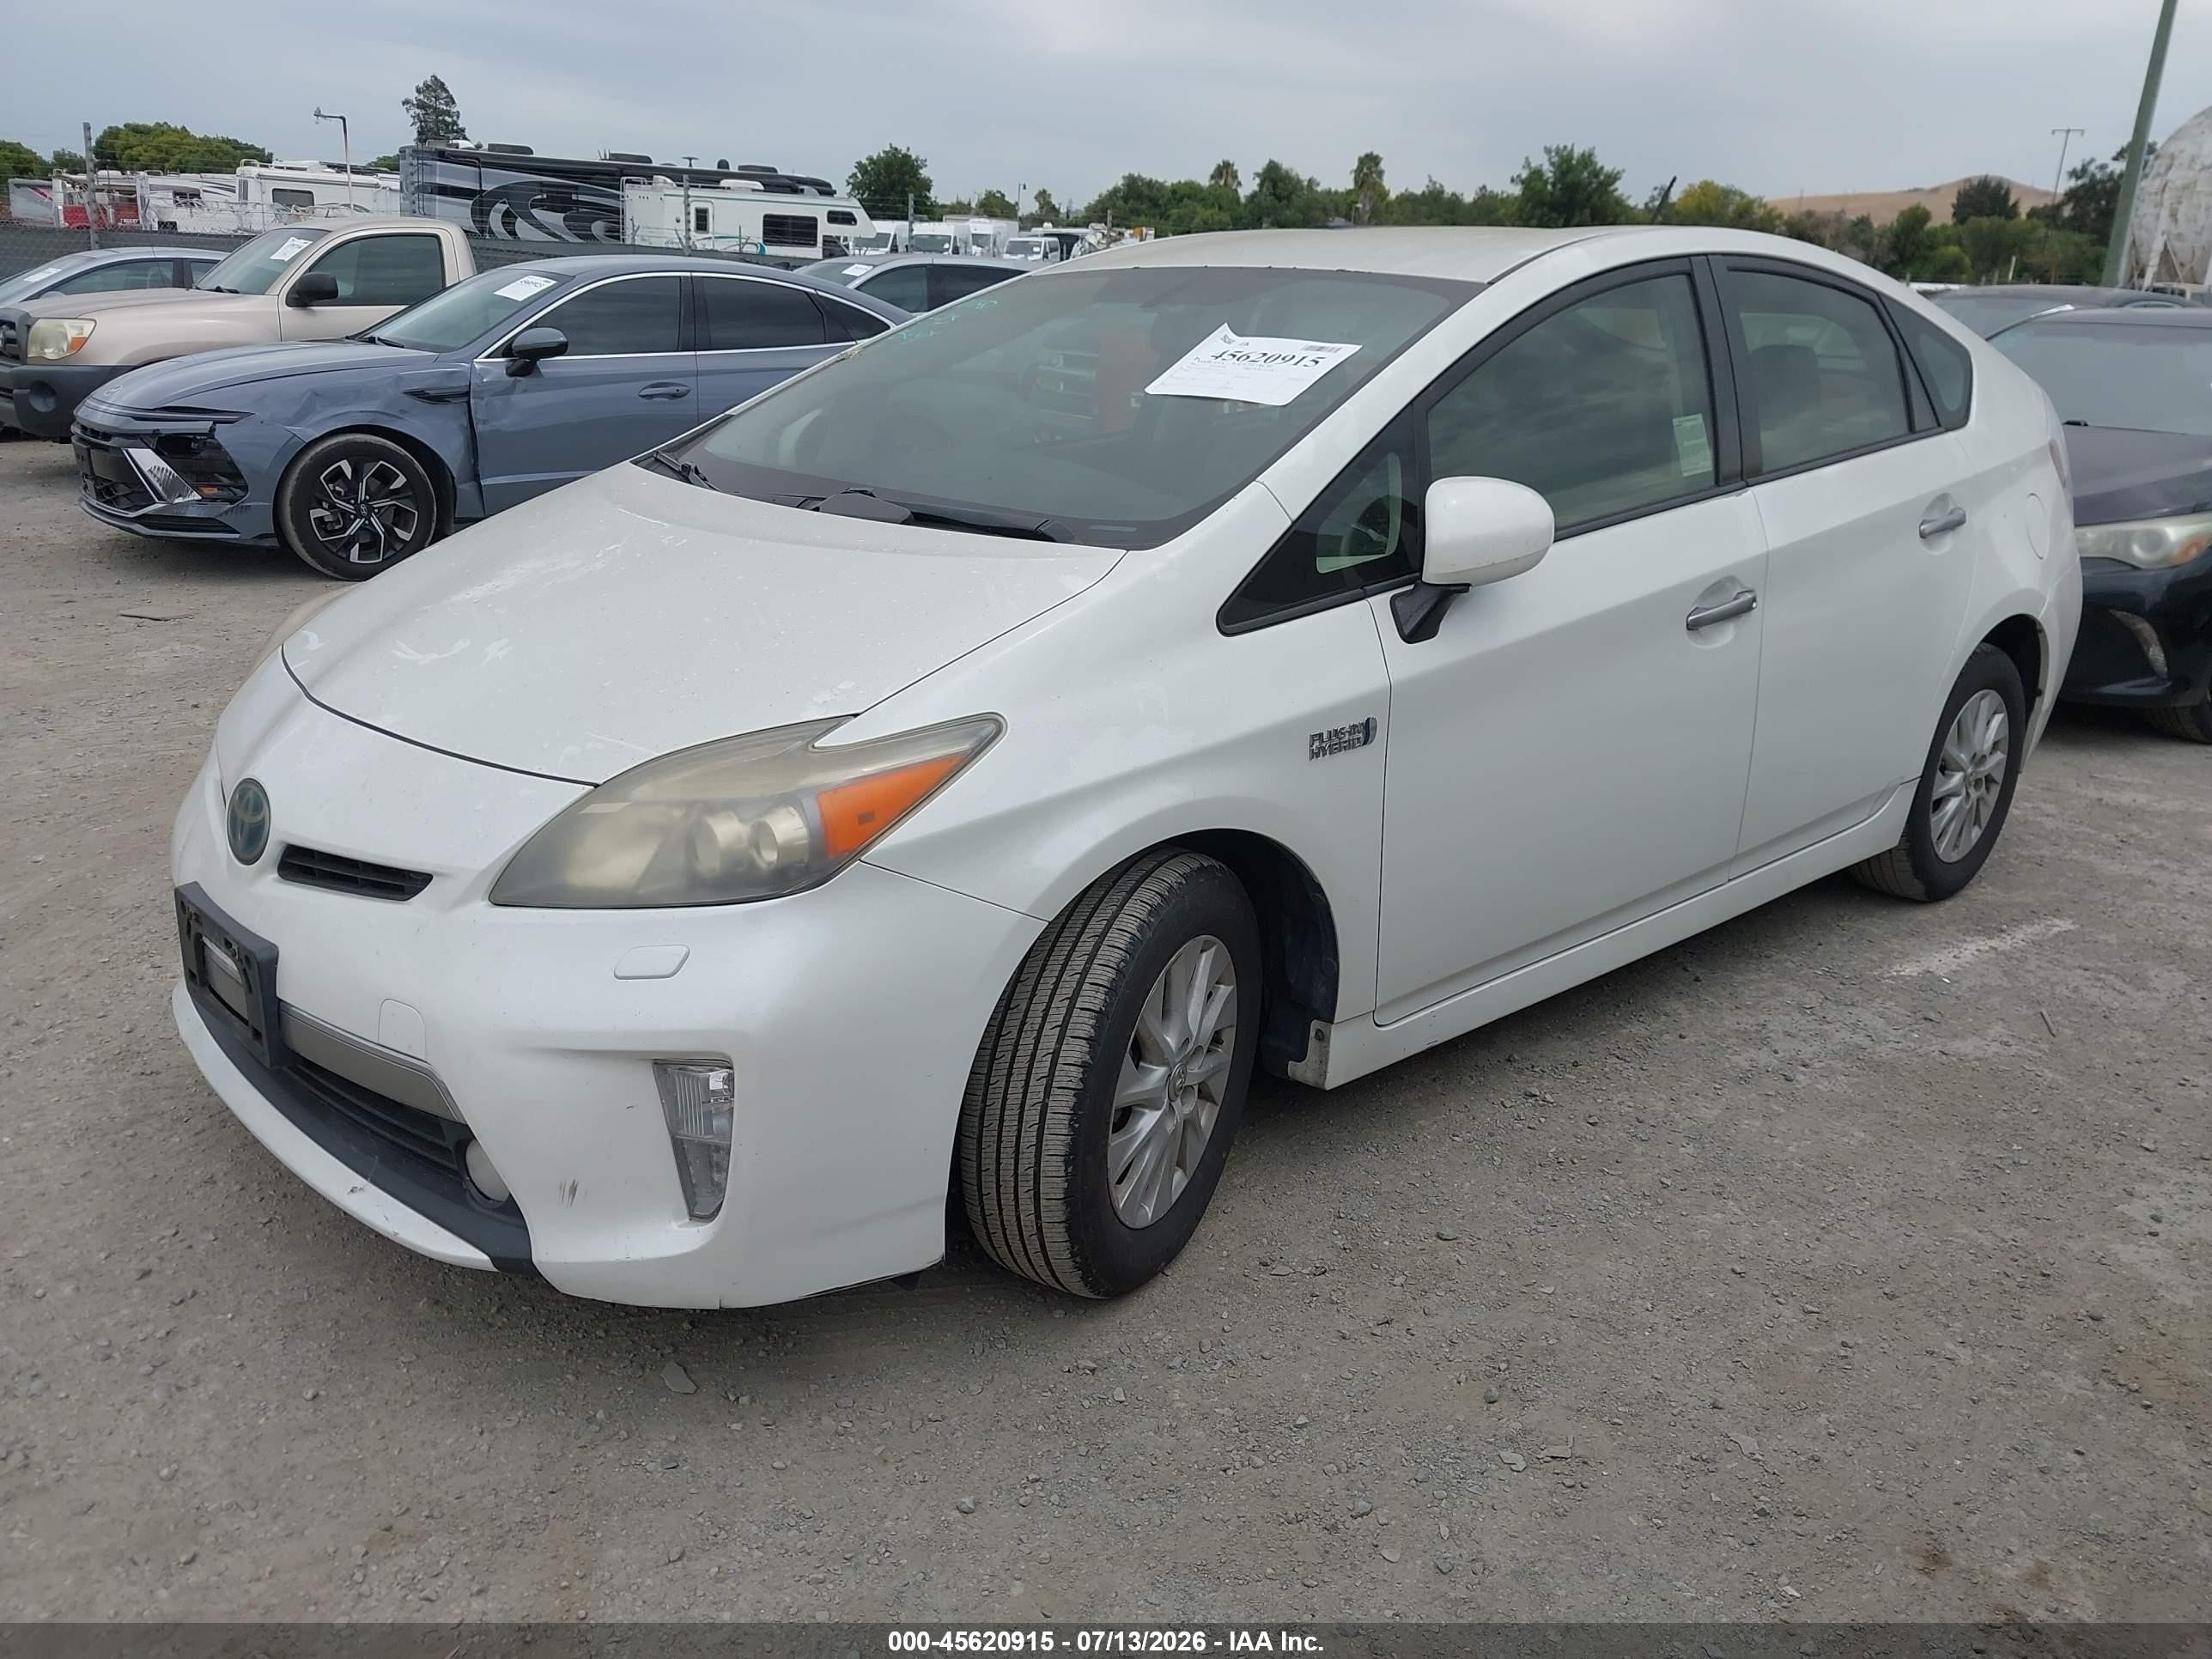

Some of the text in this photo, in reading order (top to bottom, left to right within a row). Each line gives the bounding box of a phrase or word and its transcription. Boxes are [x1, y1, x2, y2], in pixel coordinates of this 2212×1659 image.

[1211, 349, 1326, 368] 45620915
[1310, 722, 1364, 744] PLUG-IN
[1310, 736, 1364, 760] HYBRID
